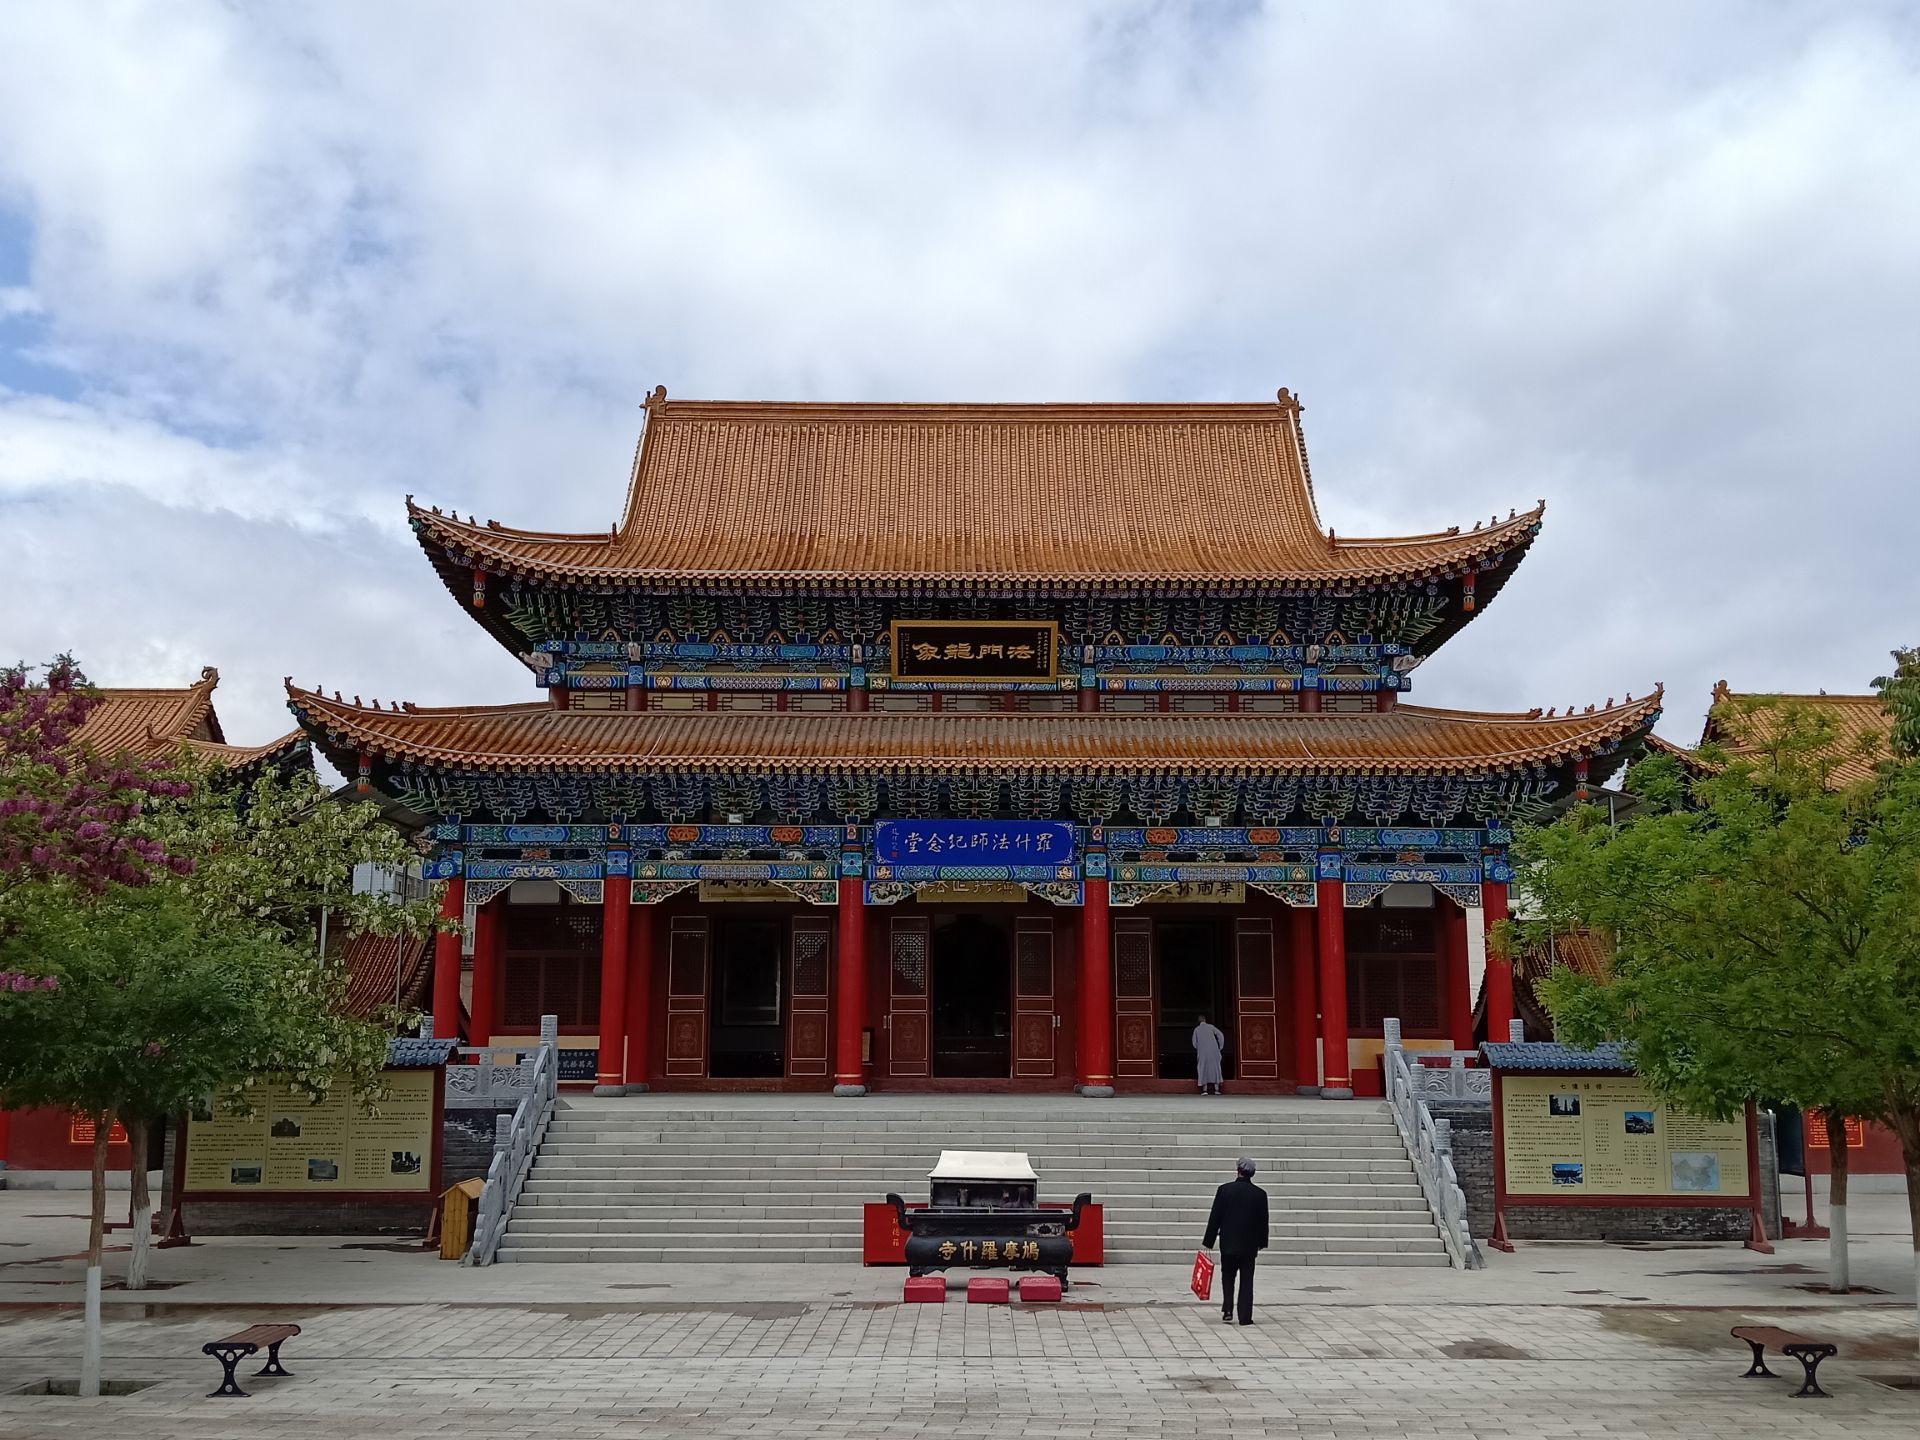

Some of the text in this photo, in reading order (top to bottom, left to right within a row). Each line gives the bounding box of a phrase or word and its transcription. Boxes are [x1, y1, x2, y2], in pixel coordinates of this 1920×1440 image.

[911, 642, 1036, 661] 法門龍象
[938, 1240, 1040, 1261] 鳩摩羅什寺
